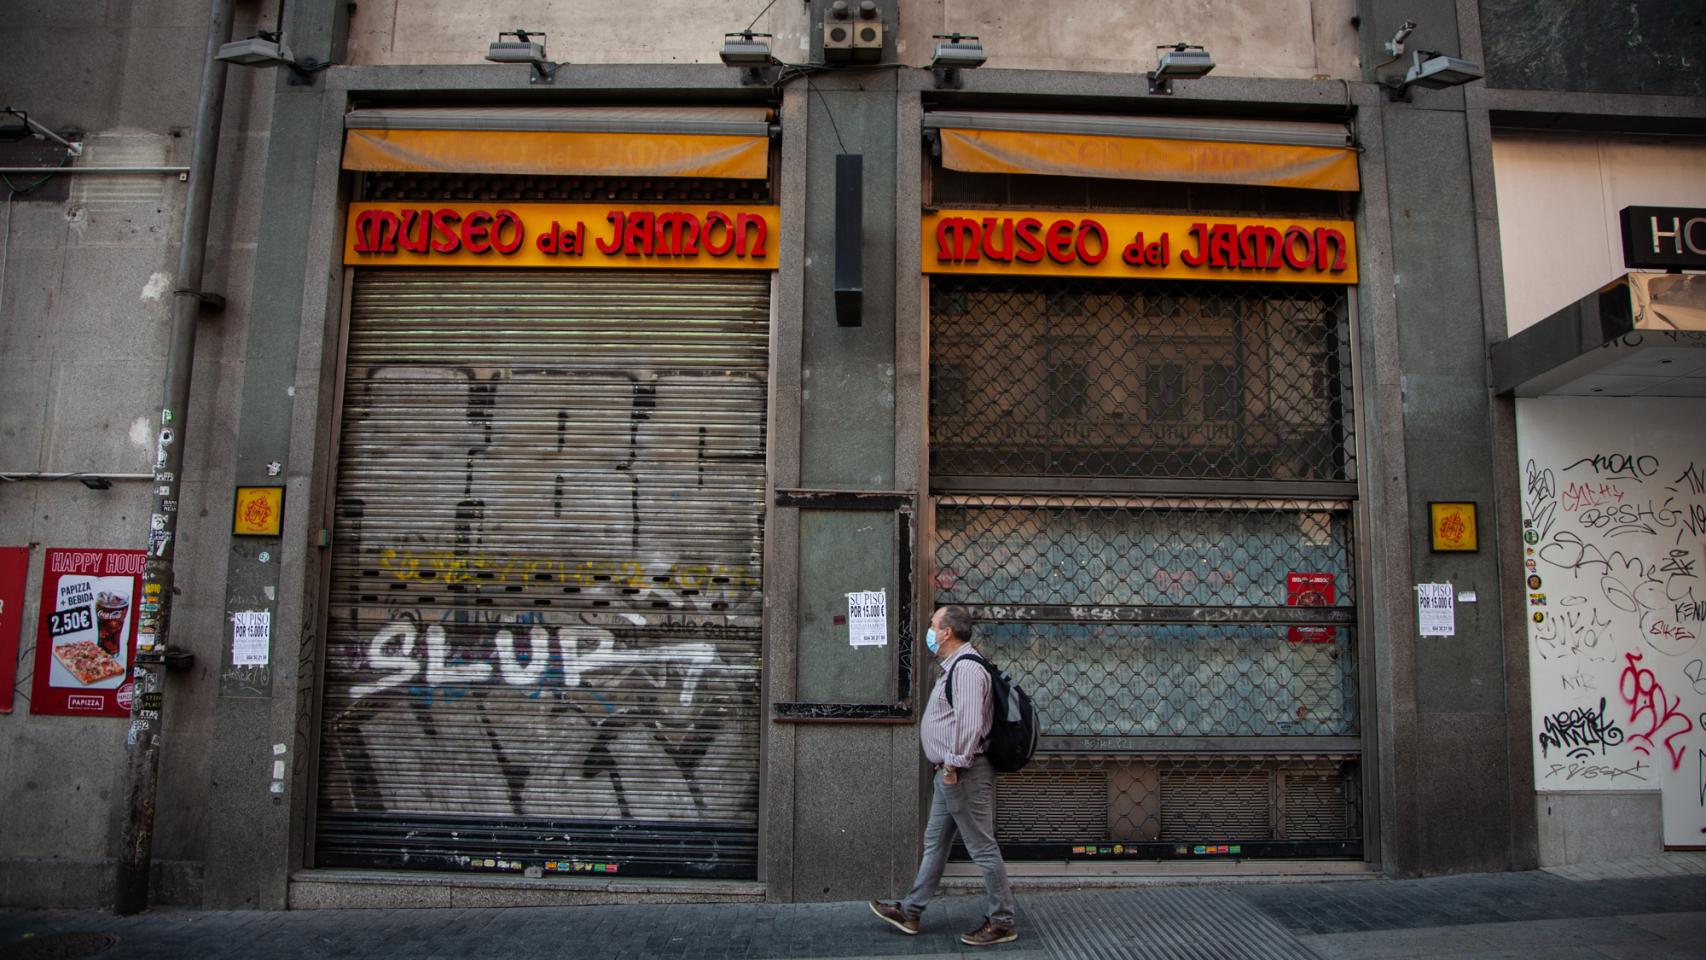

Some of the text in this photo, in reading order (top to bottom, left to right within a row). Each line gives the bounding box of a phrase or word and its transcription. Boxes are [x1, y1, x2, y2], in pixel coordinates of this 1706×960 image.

[354, 208, 767, 257] MUSEO del JAMON
[936, 217, 1348, 271] MUSEO del JAMON
[51, 552, 148, 574] HAPPY HOUR
[60, 582, 91, 596] PAPIZZA
[1420, 585, 1451, 597] SU PISO
[68, 593, 94, 606] BEBIDA
[850, 593, 884, 605] SU PISO
[1420, 597, 1430, 608] POR
[850, 605, 861, 617] POR
[863, 605, 880, 617] 15.000
[51, 609, 90, 635] 2,50€
[236, 613, 268, 625] SU PISO
[236, 626, 246, 637] POR
[248, 626, 264, 637] 15.000
[71, 698, 100, 706] PAPIZZA
